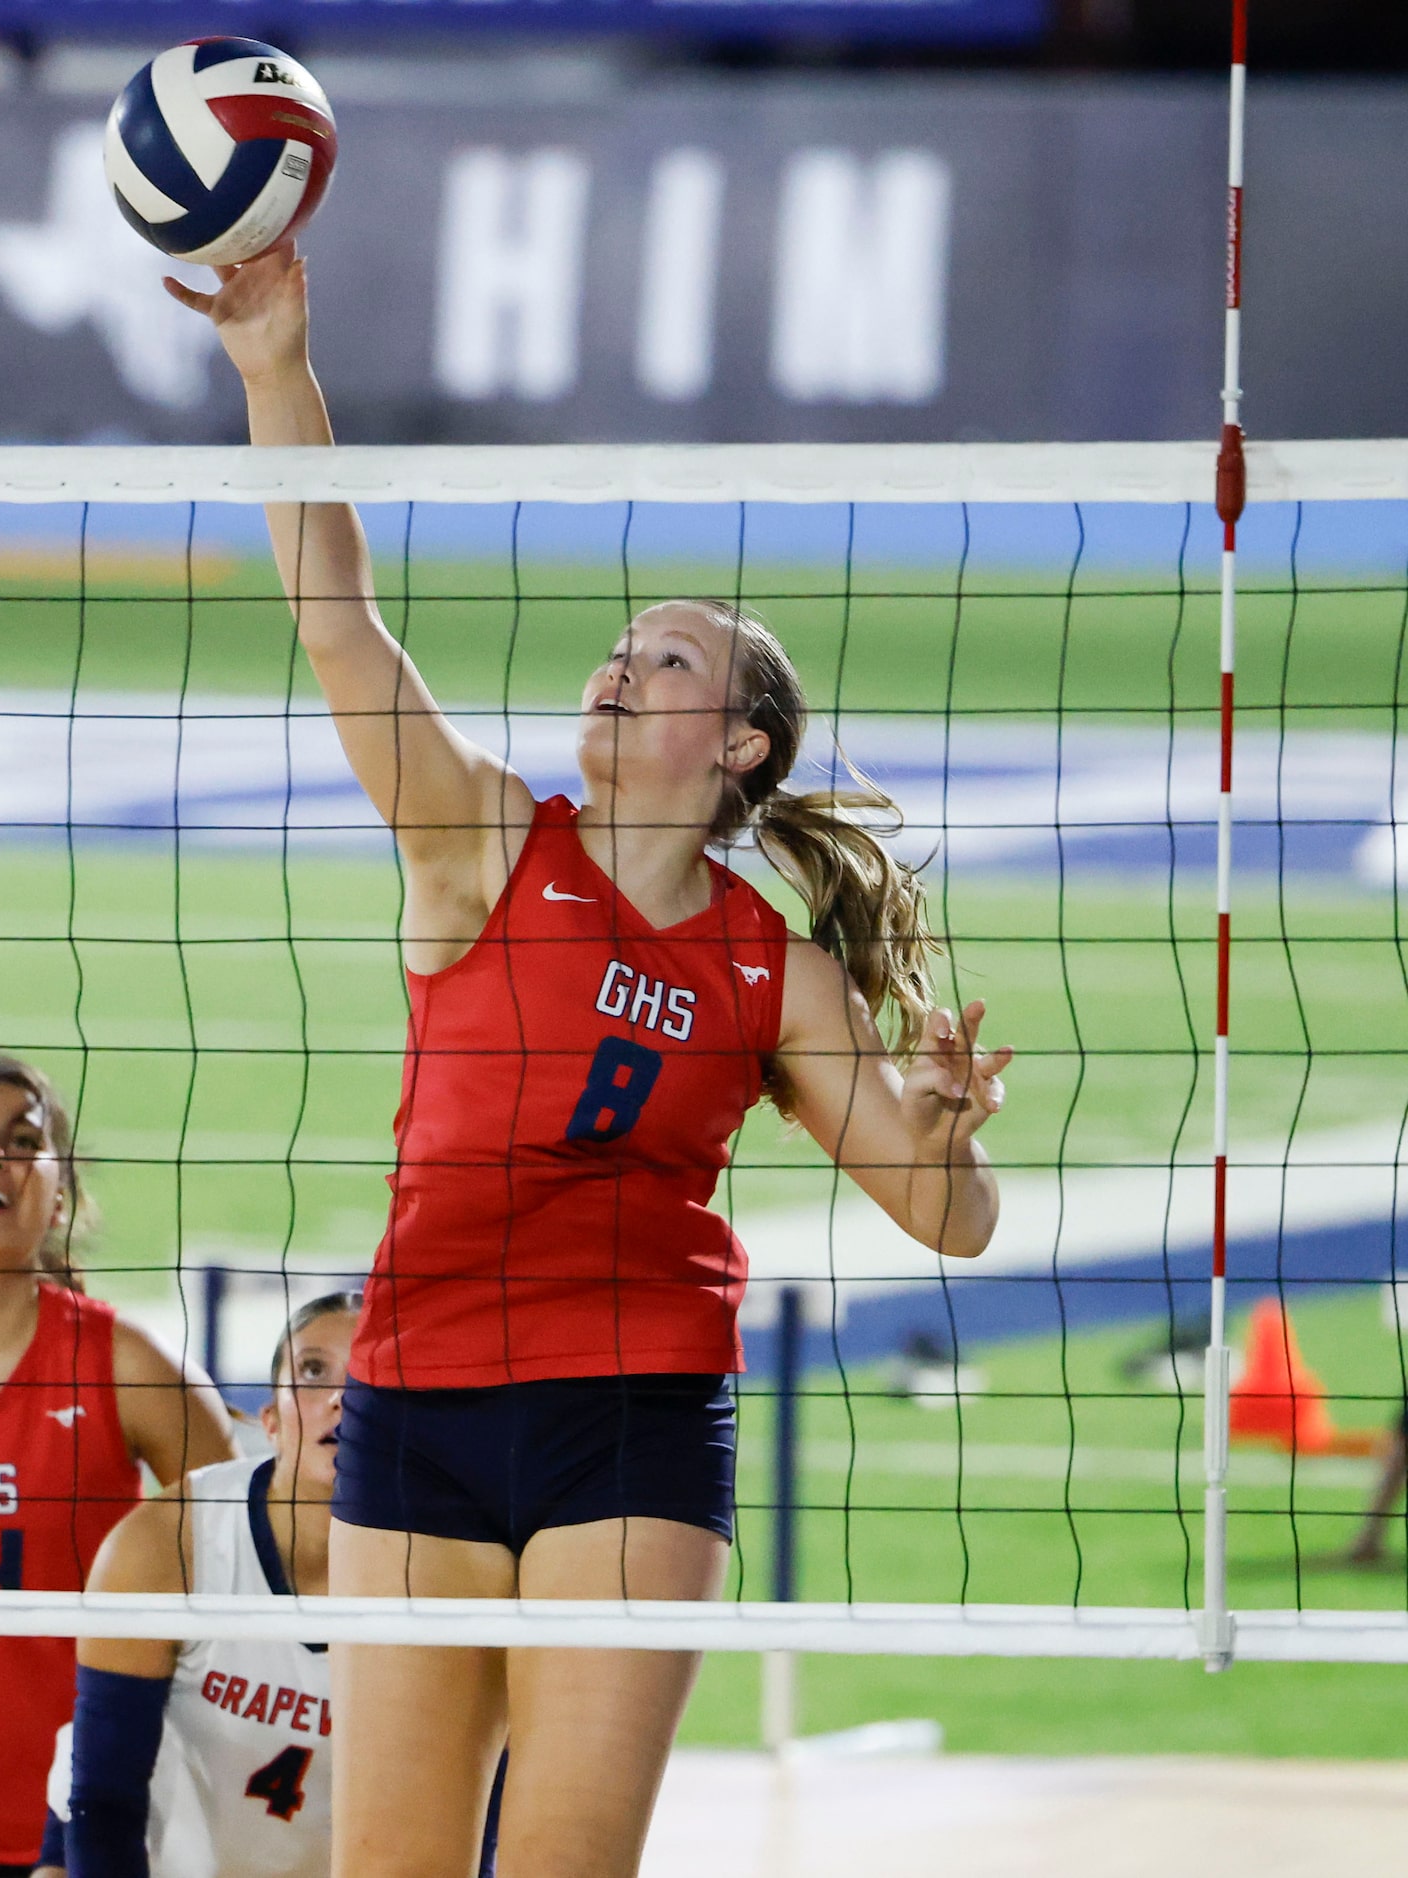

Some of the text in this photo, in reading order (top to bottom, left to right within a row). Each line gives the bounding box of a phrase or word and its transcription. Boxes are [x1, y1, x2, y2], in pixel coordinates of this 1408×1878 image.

[435, 148, 952, 400] HIM
[595, 958, 697, 1042] GHS
[566, 1035, 663, 1143] 8
[244, 1743, 315, 1823] 4
